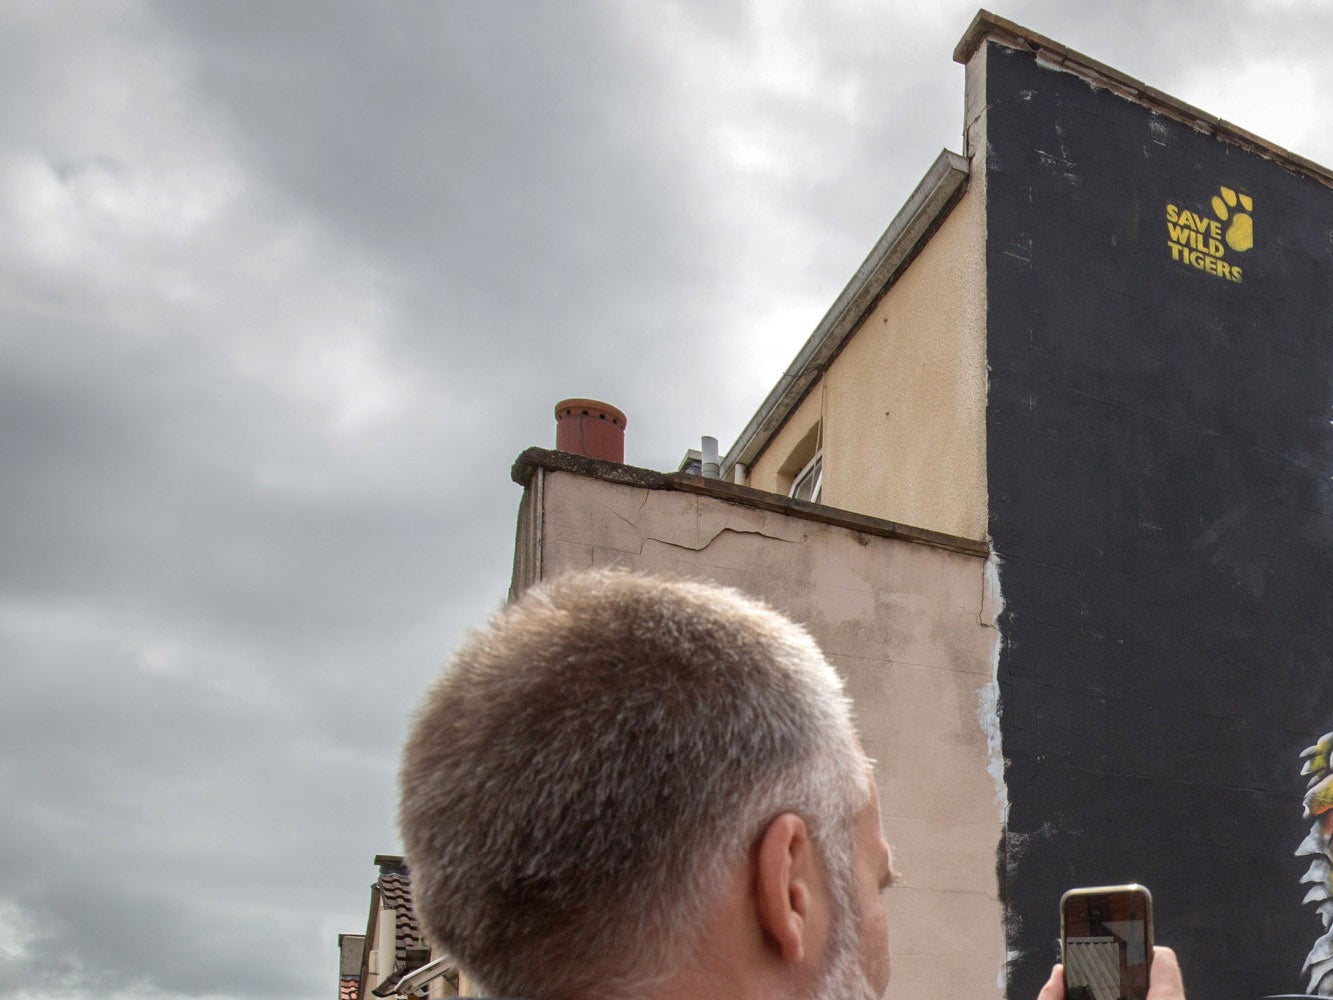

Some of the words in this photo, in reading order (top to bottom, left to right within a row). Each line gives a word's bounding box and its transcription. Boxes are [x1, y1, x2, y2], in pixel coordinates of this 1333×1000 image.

[1166, 204, 1222, 239] SAVE
[1167, 222, 1224, 258] WILD
[1168, 241, 1242, 283] TIGERS
